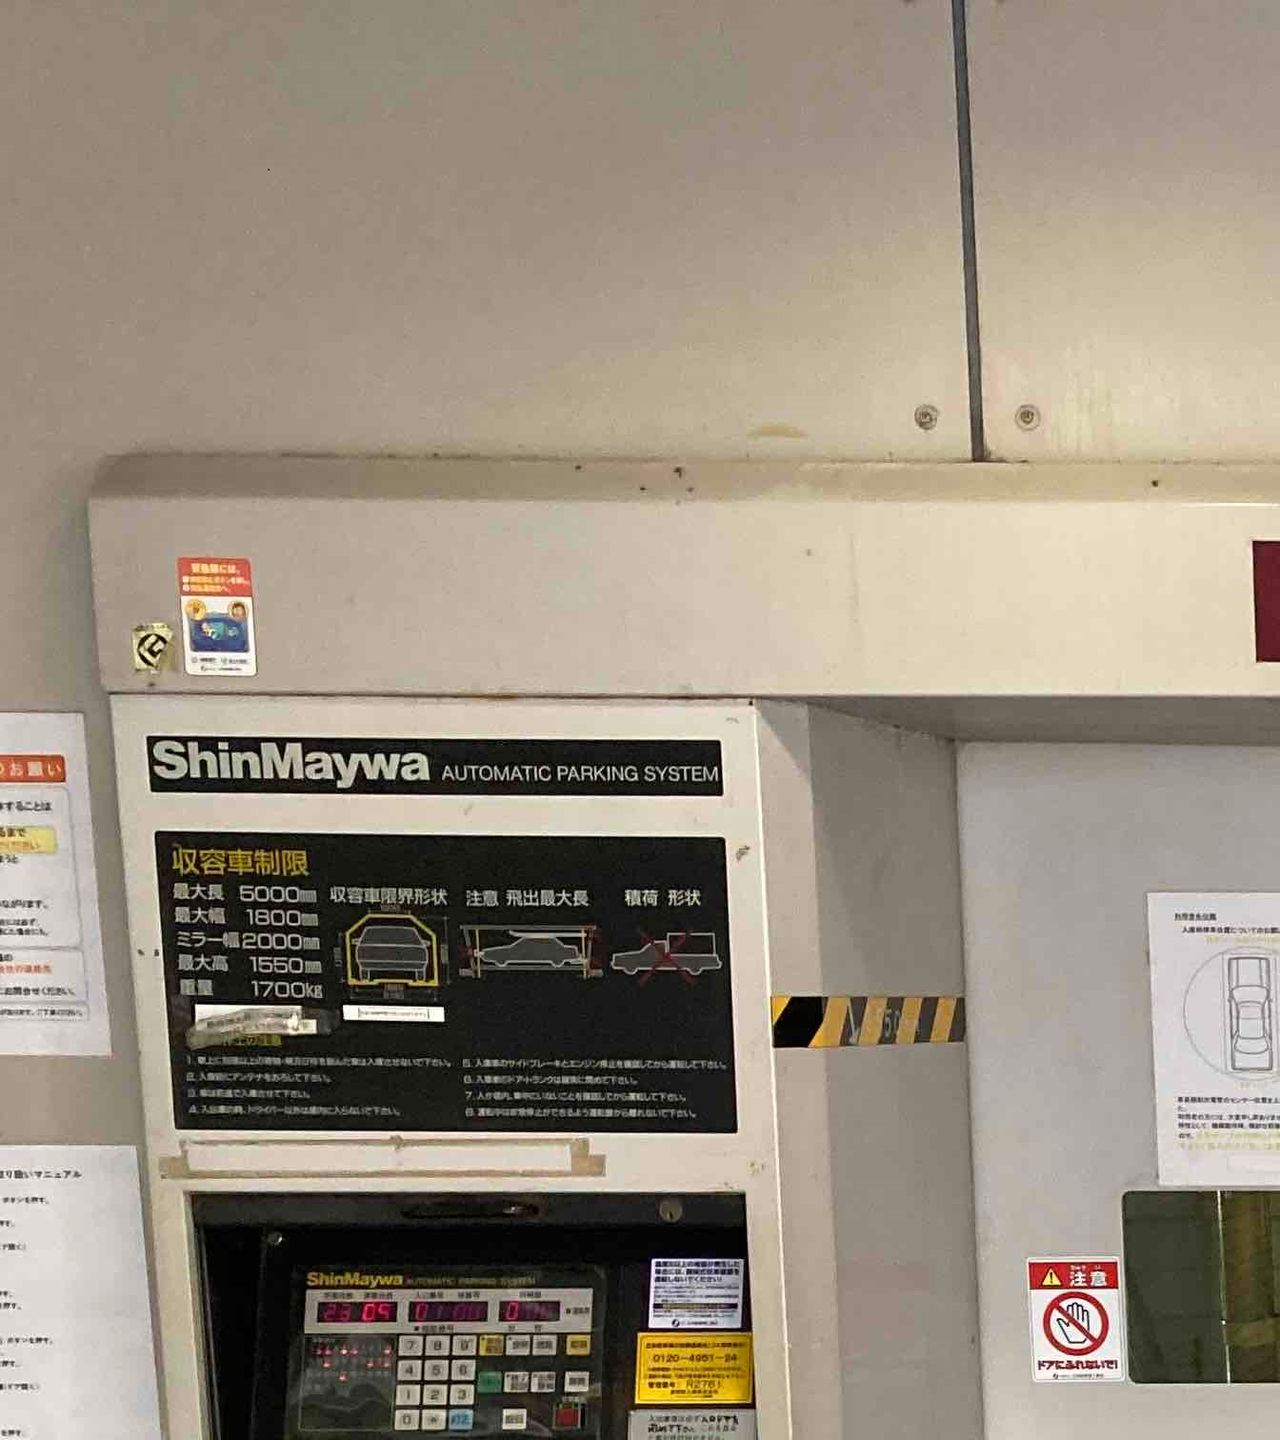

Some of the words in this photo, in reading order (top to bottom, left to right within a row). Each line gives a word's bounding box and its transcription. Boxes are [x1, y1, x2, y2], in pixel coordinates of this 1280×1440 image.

[152, 741, 430, 787] ShinMaywa
[441, 764, 551, 782] AUTOMATIC
[557, 764, 639, 782] PARKING
[644, 764, 719, 782] SYSTEM
[172, 849, 310, 876] 収容車制限
[173, 883, 225, 901] 最大長
[329, 887, 448, 906] 収容車限界形状
[466, 890, 499, 907] 注意
[624, 889, 658, 907] 積荷
[668, 889, 701, 907] 形状
[174, 907, 226, 924] 最大幅
[176, 932, 240, 948] ミラー幅
[178, 954, 229, 972] 最大高
[306, 1271, 404, 1288] ShinMaywa
[1069, 1271, 1107, 1287] 注意
